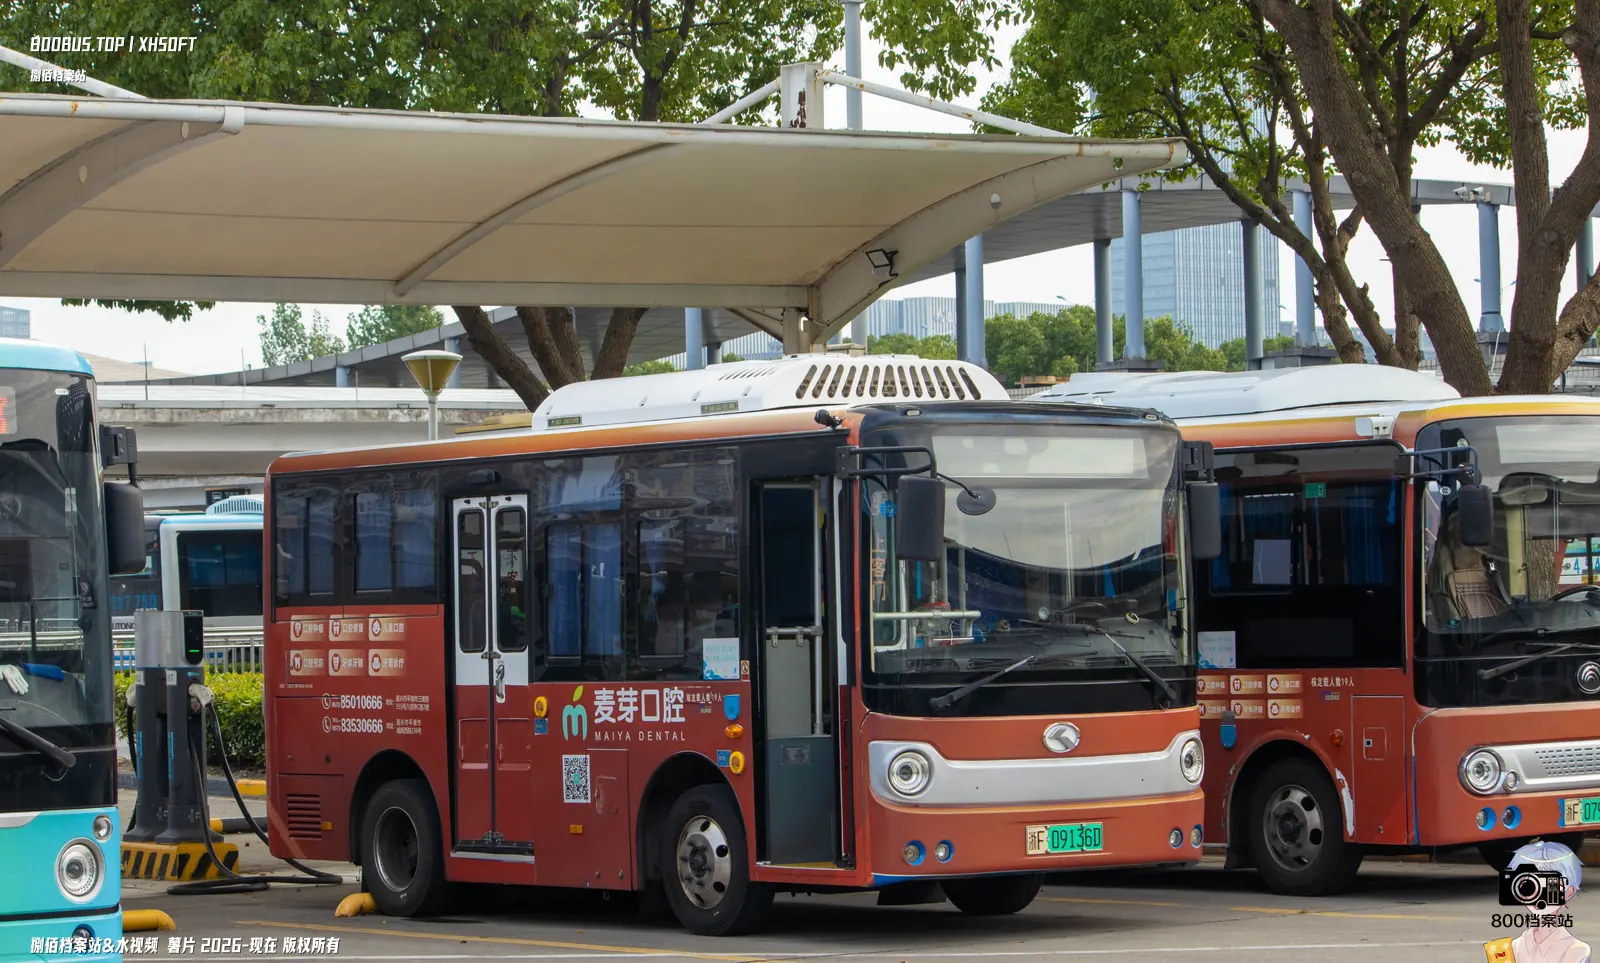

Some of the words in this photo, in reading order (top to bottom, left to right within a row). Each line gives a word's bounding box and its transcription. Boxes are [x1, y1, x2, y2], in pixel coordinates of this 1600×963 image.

[340, 695, 383, 710] 85010666
[593, 686, 686, 724] 麦芽口腔
[341, 718, 383, 733] 83530666
[595, 731, 632, 741] MAIYA
[639, 731, 686, 741] DENTAL
